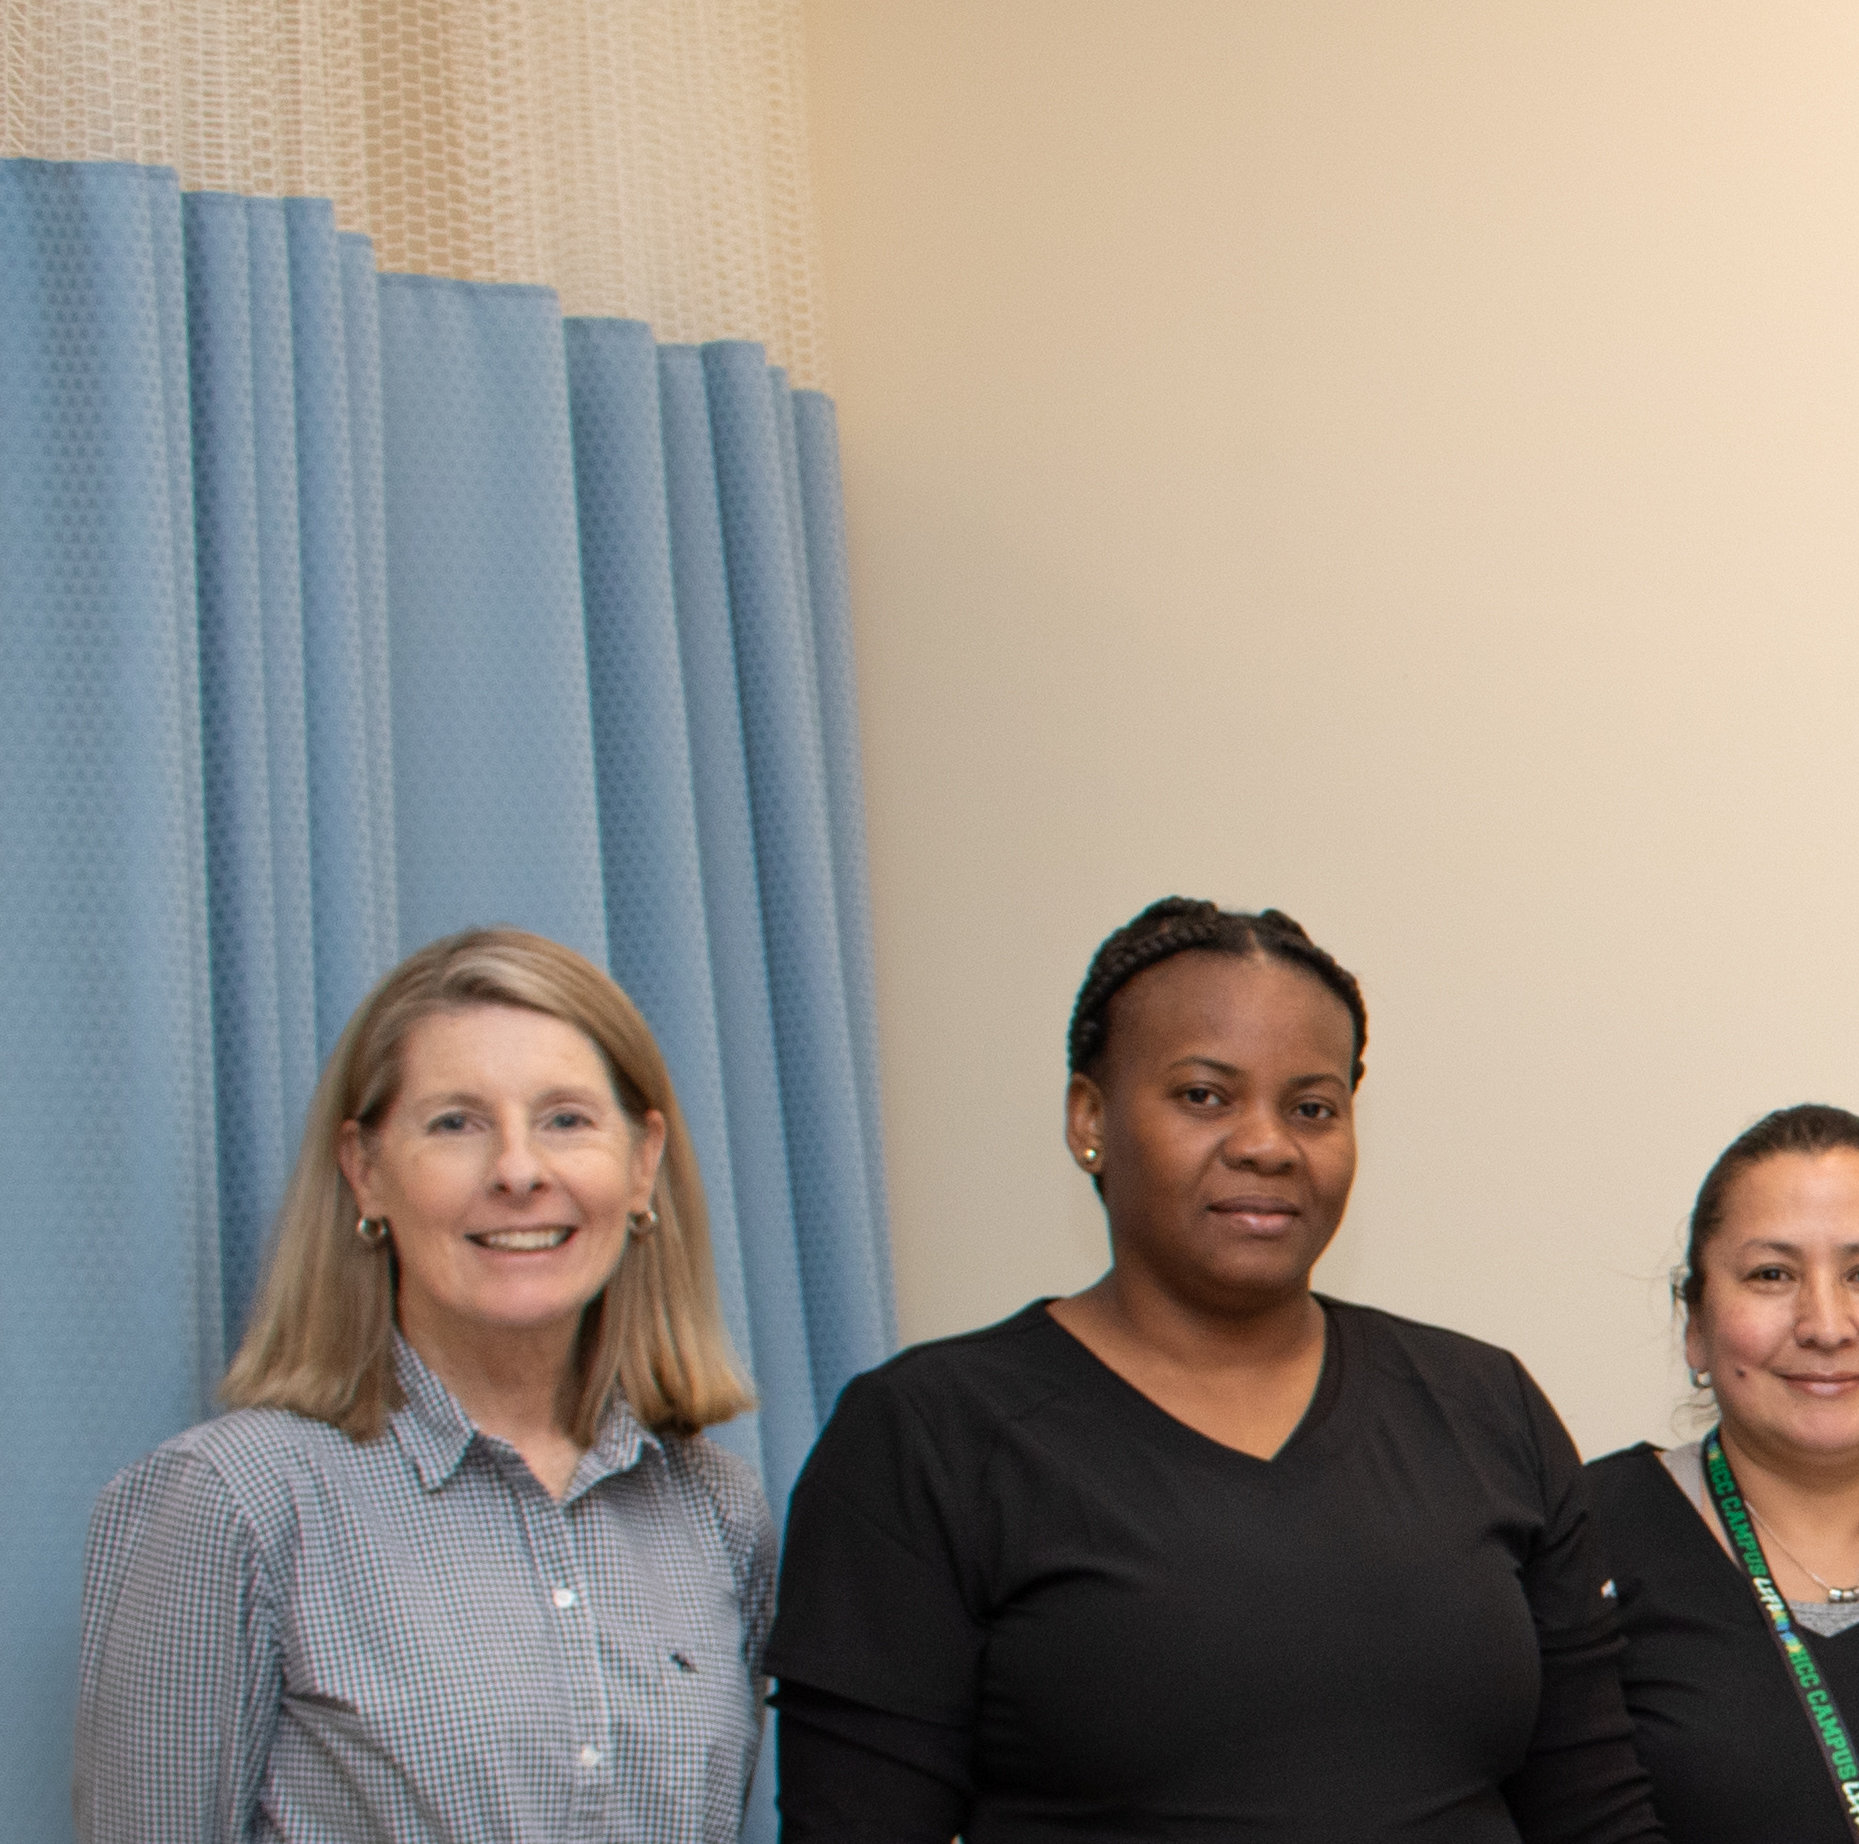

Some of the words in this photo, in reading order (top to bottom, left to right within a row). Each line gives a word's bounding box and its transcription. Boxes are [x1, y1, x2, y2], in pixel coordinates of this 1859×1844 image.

[1721, 1496, 1769, 1577] CAMPUS
[1788, 1648, 1821, 1689] HCC
[1806, 1689, 1858, 1781] CAMPUS
